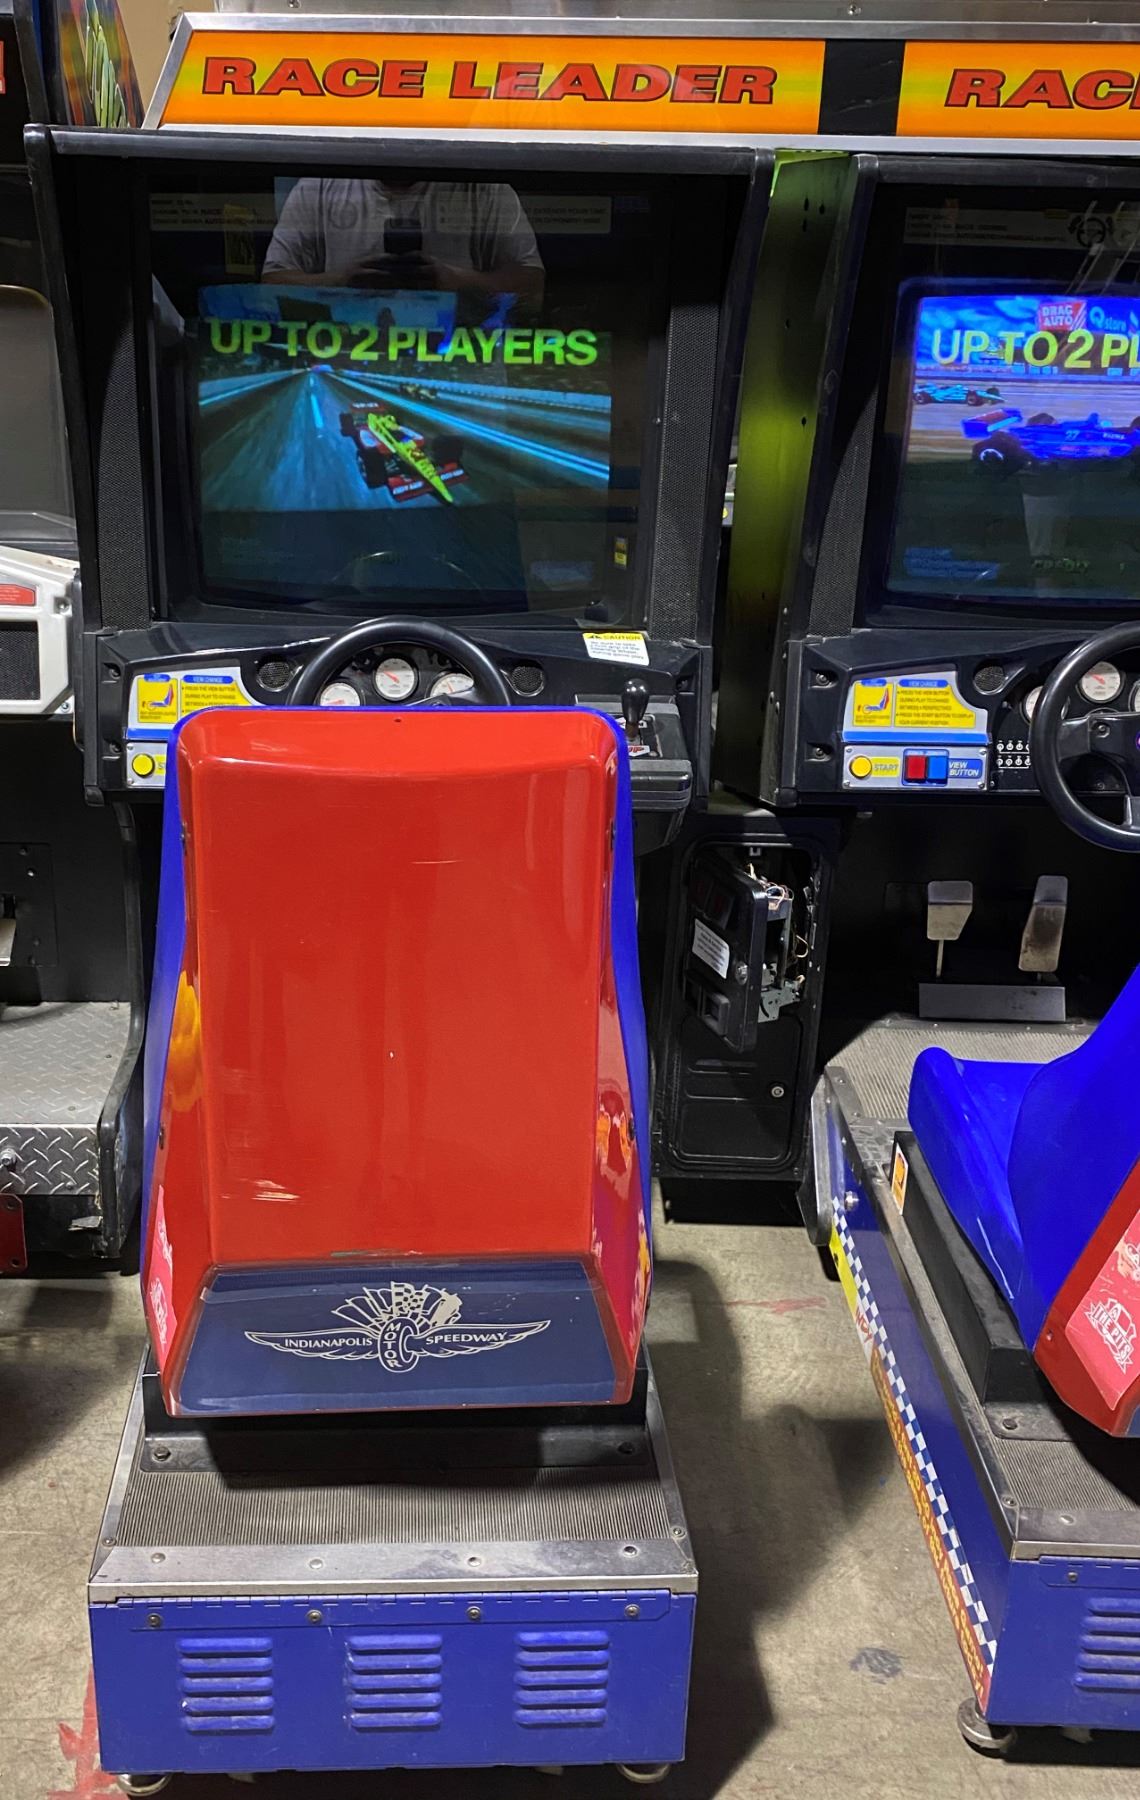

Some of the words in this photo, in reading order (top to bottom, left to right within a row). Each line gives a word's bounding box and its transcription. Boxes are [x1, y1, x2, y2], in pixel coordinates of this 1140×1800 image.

[201, 56, 428, 98] RACE
[449, 61, 778, 104] LEADER
[944, 69, 1140, 110] RAC
[1042, 305, 1073, 316] DRAG
[1044, 316, 1073, 327] AUTO
[207, 318, 274, 355] UP
[278, 321, 342, 358] TO
[350, 322, 379, 361] 2
[388, 328, 599, 367] PLAYERS
[931, 329, 990, 365] UP
[998, 331, 1059, 367] TO
[1064, 329, 1094, 368] 2
[284, 1337, 373, 1349] INDIANAPOLIS
[382, 1322, 402, 1368] MOTOR
[425, 1331, 508, 1346] SPEEDWAY
[1093, 1304, 1112, 1329] THE
[1110, 1325, 1131, 1359] PITS
